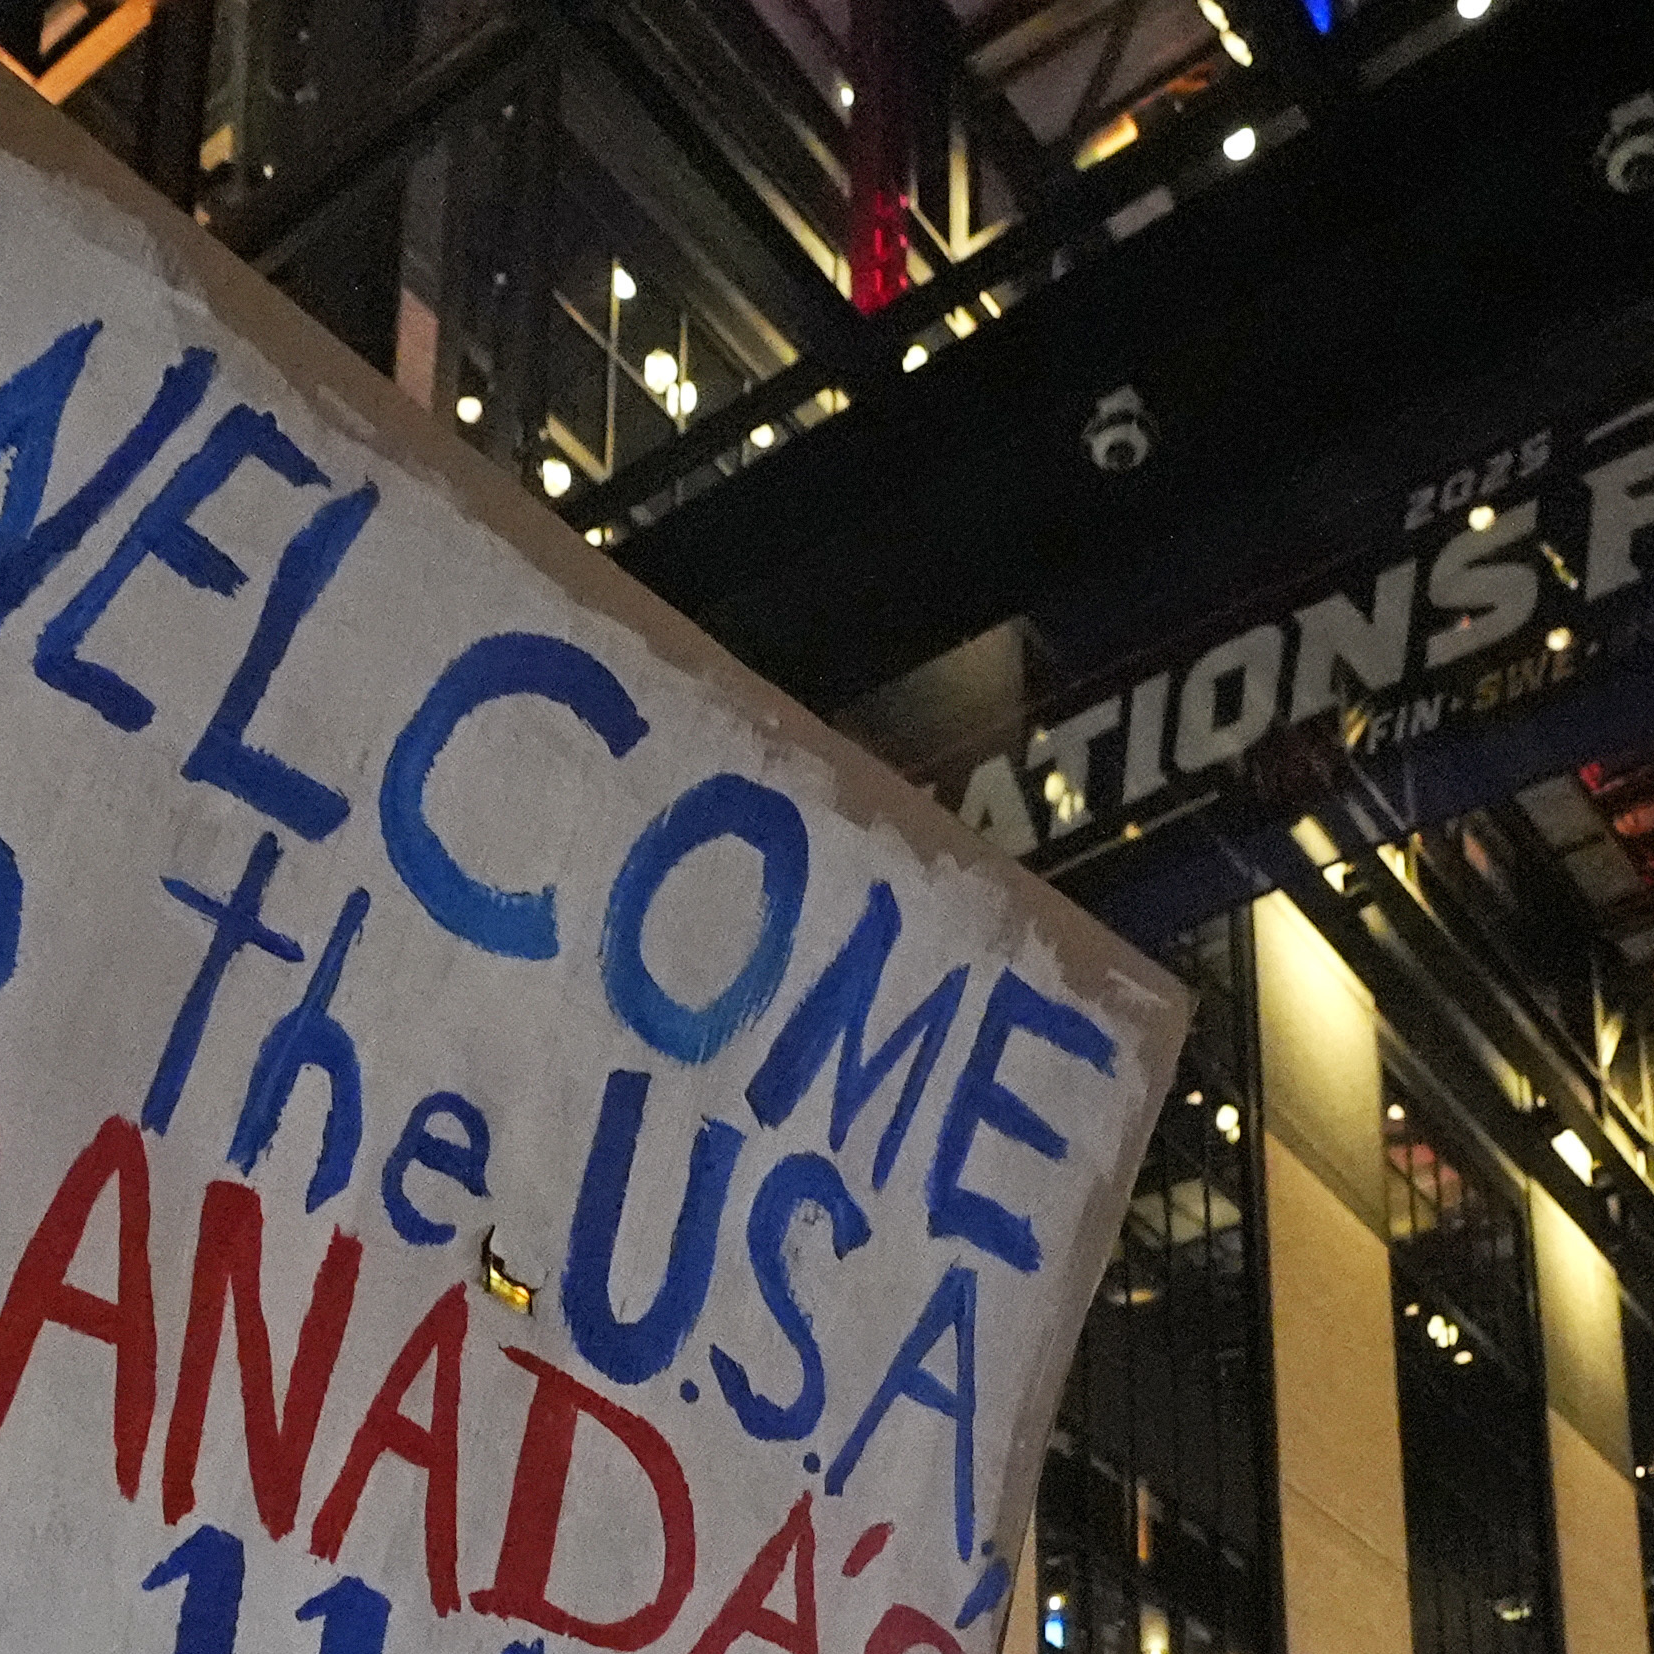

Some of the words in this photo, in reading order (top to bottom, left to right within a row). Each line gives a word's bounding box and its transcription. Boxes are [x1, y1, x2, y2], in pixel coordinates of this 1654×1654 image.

[1405, 430, 1552, 531] 2025
[1366, 698, 1442, 757] FIN
[161, 832, 493, 1250] the
